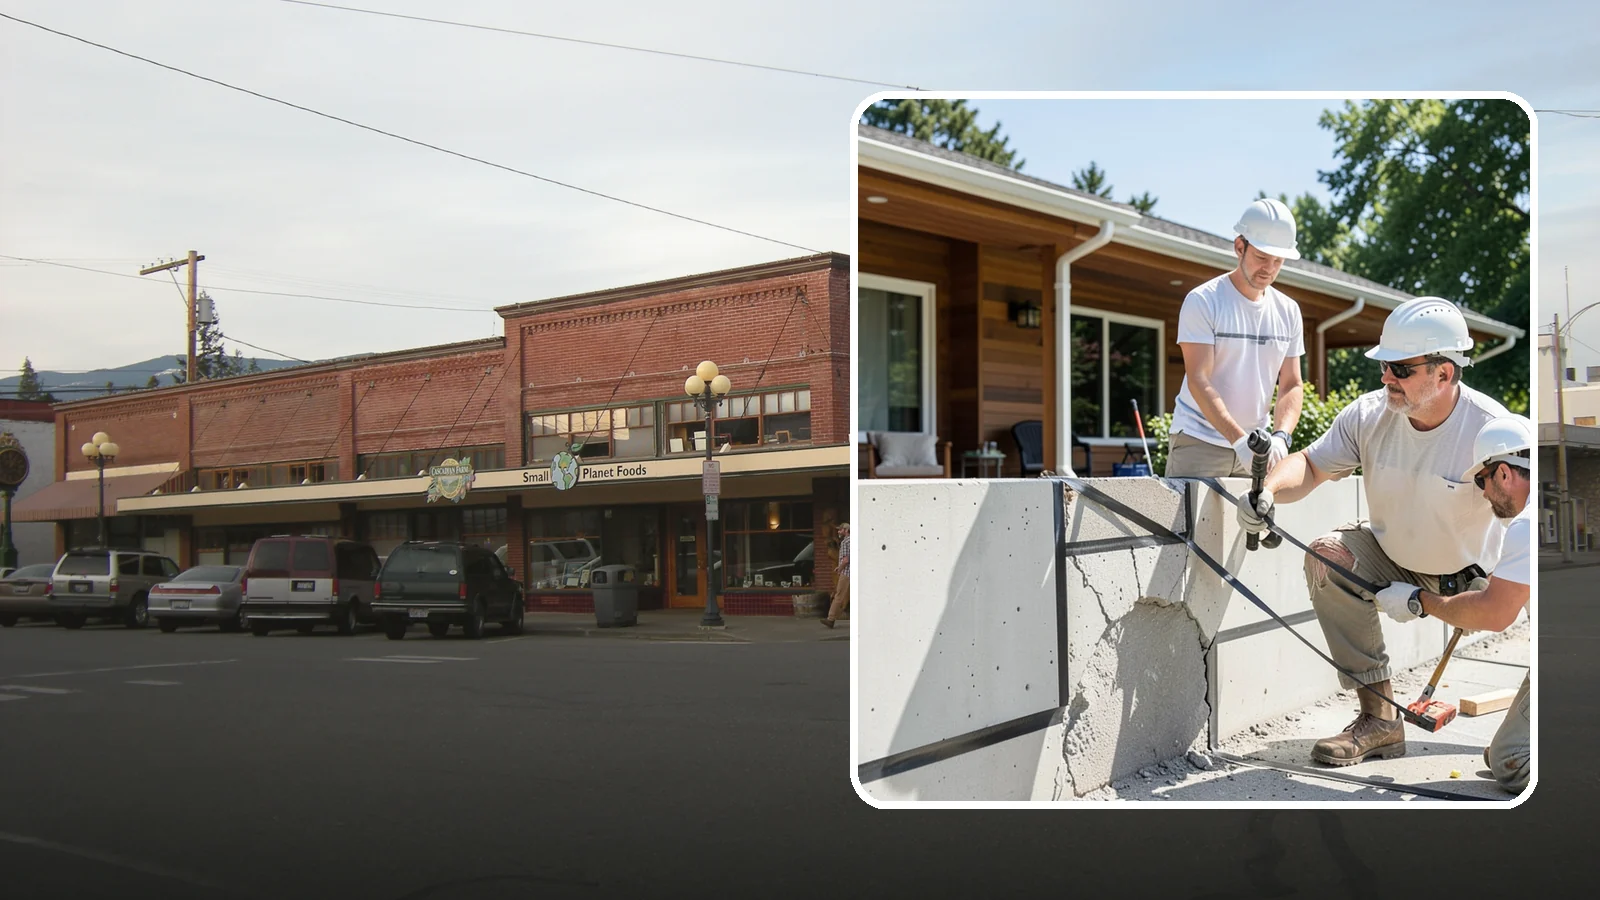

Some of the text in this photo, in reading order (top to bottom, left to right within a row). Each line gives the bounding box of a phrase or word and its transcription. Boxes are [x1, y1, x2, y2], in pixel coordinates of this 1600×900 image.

[523, 464, 647, 483] Small Planet Foods
